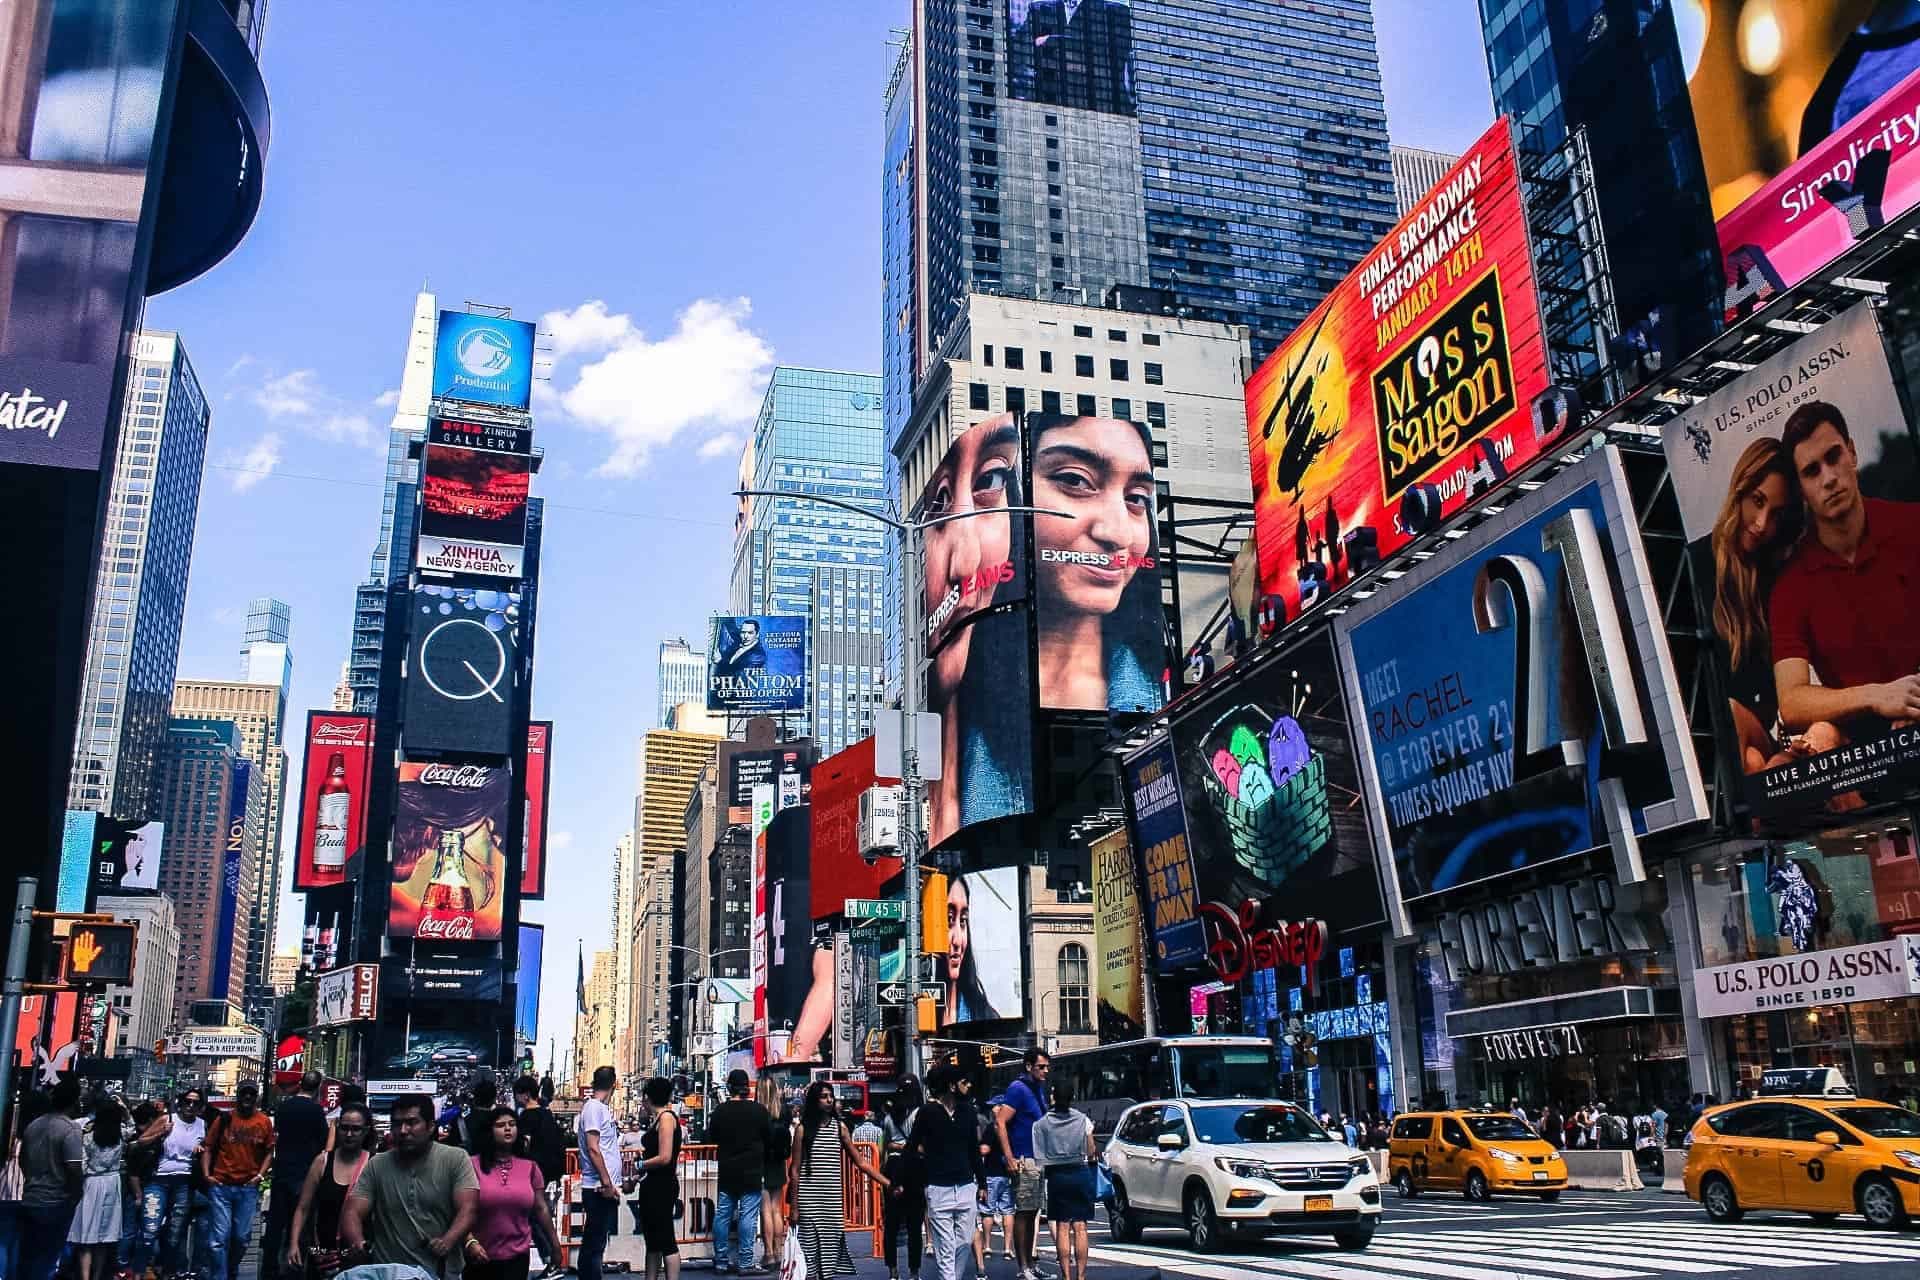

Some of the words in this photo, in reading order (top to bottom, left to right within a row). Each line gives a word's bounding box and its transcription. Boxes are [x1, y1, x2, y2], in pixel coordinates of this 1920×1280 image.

[1358, 246, 1398, 298] FINAL
[1399, 153, 1483, 258] BROADWAY
[1372, 198, 1478, 319] PERFORMANCE
[1377, 271, 1438, 352] JANUARY
[1442, 231, 1485, 287] 14TH
[455, 374, 511, 392] Prudential
[1714, 405, 1745, 432] U.S.
[1746, 374, 1793, 413] POLO
[1798, 342, 1850, 385] ASSN.
[1746, 406, 1781, 432] SINCE
[1787, 386, 1818, 409] 1890
[443, 433, 516, 450] GALLERY
[484, 427, 517, 438] XINHUA
[426, 556, 461, 569] NEWS
[464, 560, 515, 574] AGENCY
[441, 545, 502, 562] XINHUA
[1042, 551, 1109, 565] EXPRESS
[928, 584, 960, 635] EXPRESS
[710, 675, 803, 690] PHANTOM
[743, 667, 767, 676] THE
[1365, 658, 1401, 707] MEET
[717, 689, 732, 698] OF
[735, 689, 756, 698] THE
[757, 688, 794, 697] OPERA
[1373, 671, 1473, 743] RACHEL
[1398, 713, 1483, 779] FOREVER
[1134, 785, 1150, 810] BEST
[1150, 772, 1176, 803] MUSICAL
[1390, 782, 1432, 828] TIMES
[1431, 760, 1490, 816] SQUARE
[1766, 767, 1799, 787] LIVE
[1767, 786, 1793, 798] PAMELA
[1793, 775, 1831, 791] FLANAGAN
[1145, 834, 1187, 874] COME
[859, 901, 870, 915] W
[875, 901, 889, 916] 45
[1096, 872, 1137, 913] POTTER
[1155, 889, 1194, 929] AWAY
[1436, 876, 1652, 983] FOREVER
[1713, 966, 1753, 995] U.S.
[1758, 957, 1819, 989] POLO
[1828, 947, 1901, 980] ASSN.
[887, 989, 905, 999] ONE
[1755, 990, 1805, 1008] SINCE
[1811, 985, 1856, 1002] 1890
[1483, 1029, 1560, 1063] FOREVER
[1561, 1024, 1583, 1056] 21
